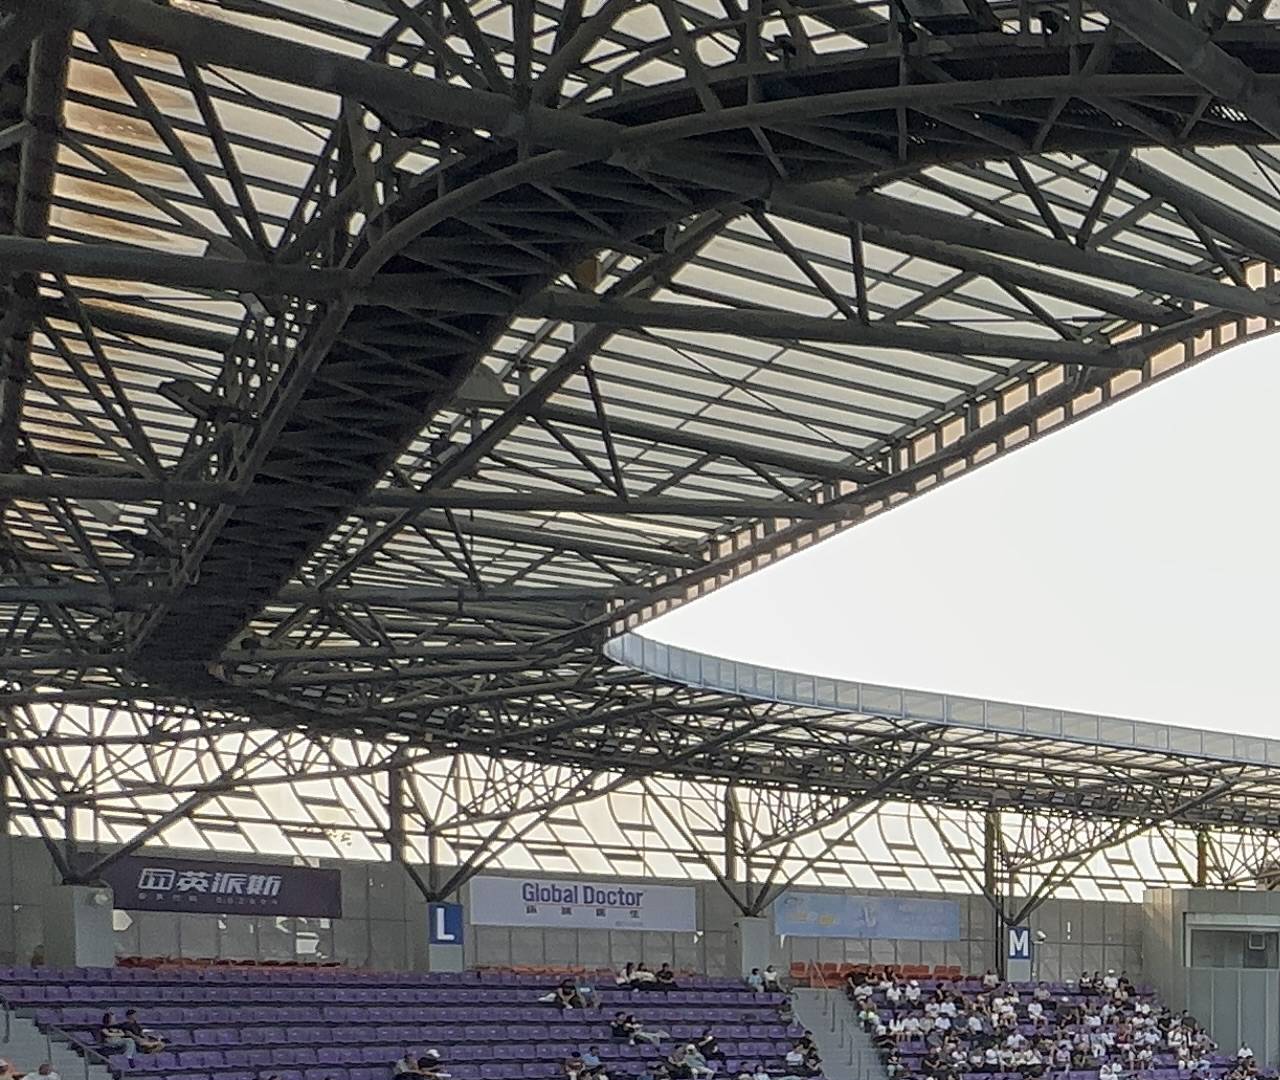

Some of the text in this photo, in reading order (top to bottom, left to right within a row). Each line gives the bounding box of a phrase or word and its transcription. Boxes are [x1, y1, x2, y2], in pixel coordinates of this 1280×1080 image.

[176, 871, 282, 897] 英派斯
[522, 882, 643, 907] Global Doctor
[436, 908, 455, 940] L
[1009, 930, 1029, 957] M
